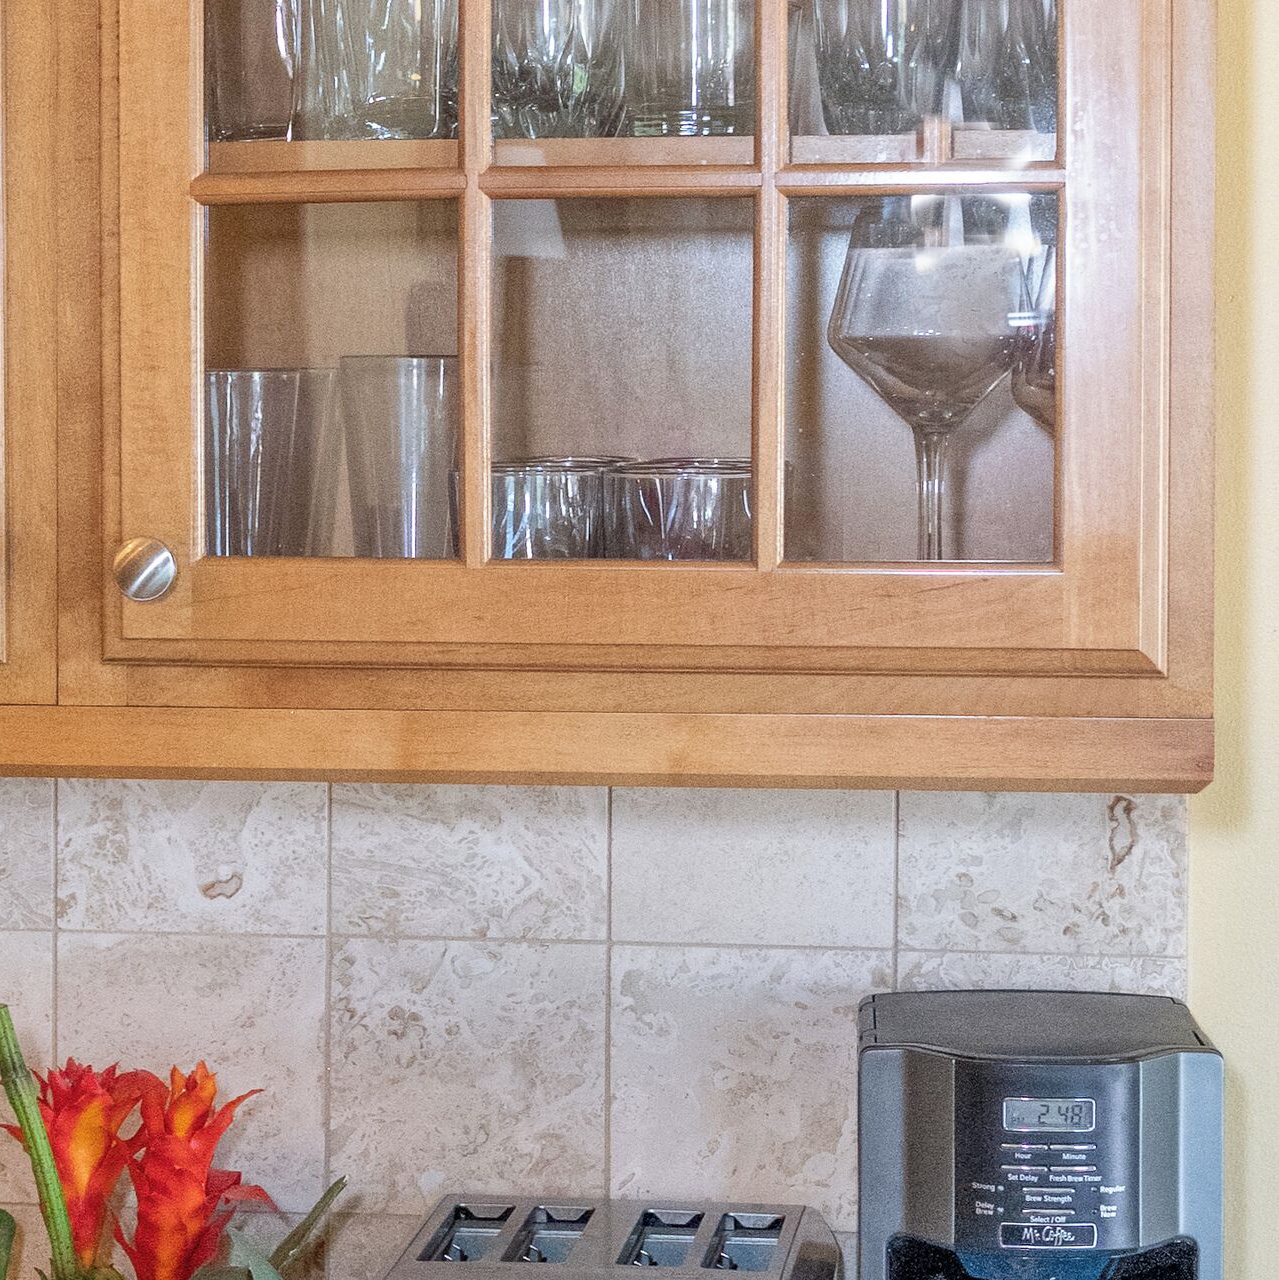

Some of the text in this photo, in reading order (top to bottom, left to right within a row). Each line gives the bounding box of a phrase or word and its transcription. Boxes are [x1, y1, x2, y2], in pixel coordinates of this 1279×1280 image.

[1015, 1152, 1032, 1160] Hour
[1008, 1174, 1039, 1183] Set Delay
[1049, 1174, 1066, 1182] Fresh
[972, 1181, 996, 1192] Strong
[1100, 1184, 1126, 1194] Regular
[1026, 1194, 1073, 1205] Brew Strength
[975, 1201, 994, 1210] Delay
[1100, 1204, 1118, 1212] Brew
[1100, 1210, 1117, 1218] Now
[1029, 1215, 1050, 1223] Select
[1055, 1215, 1067, 1223] Off
